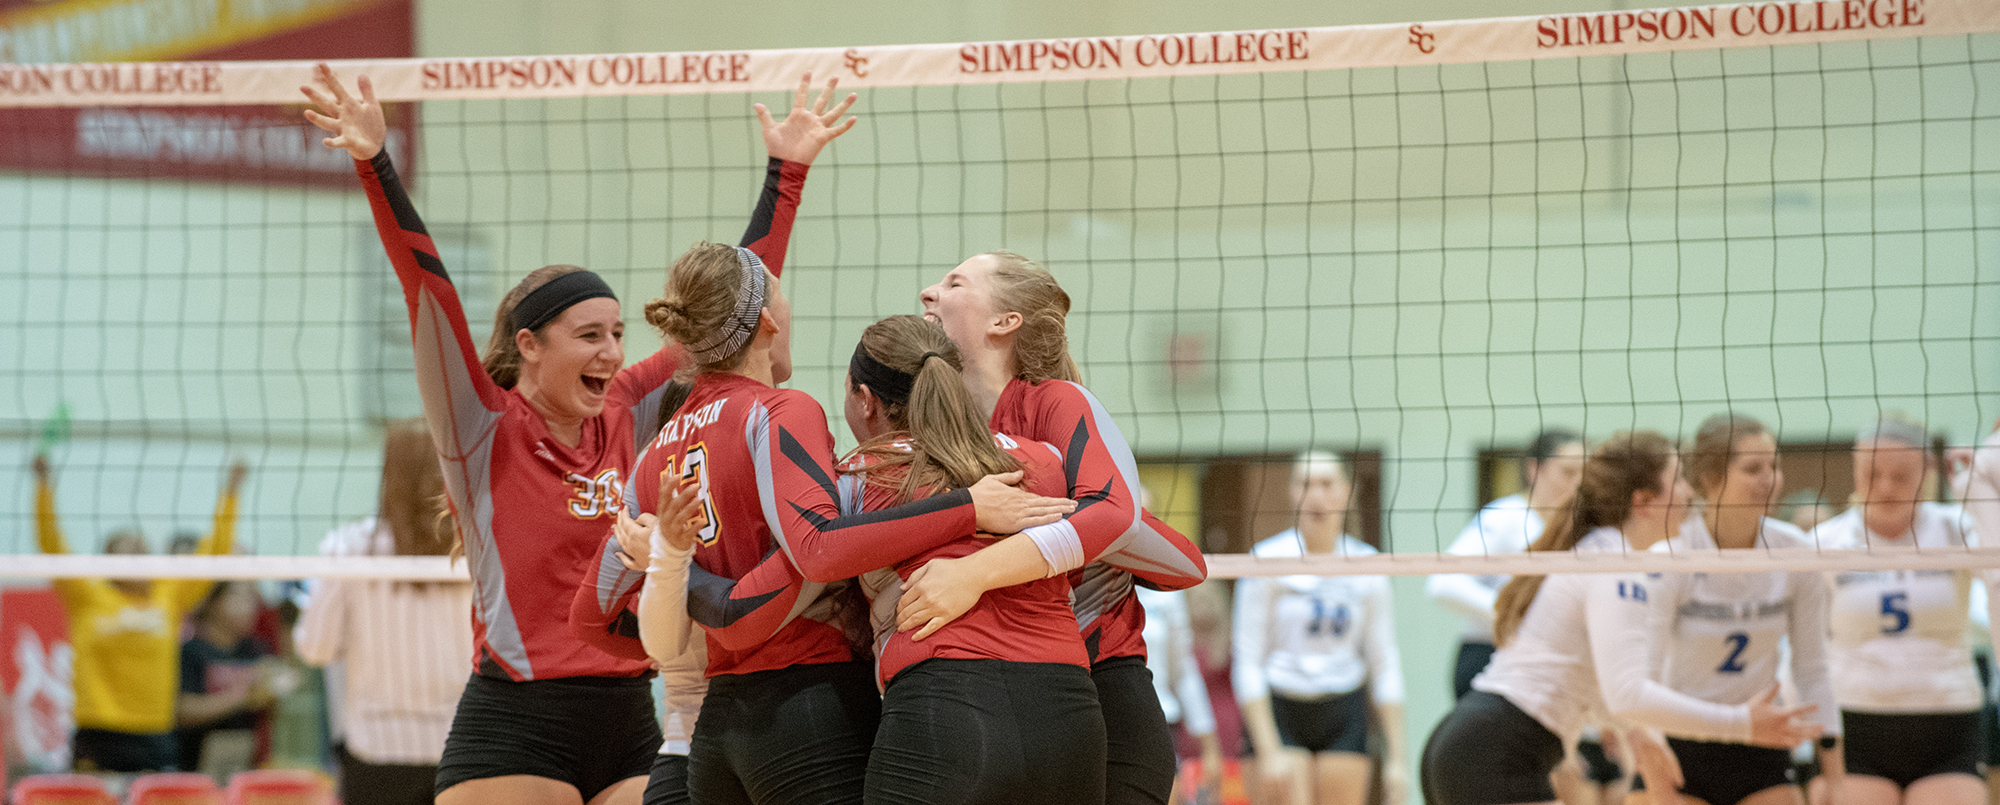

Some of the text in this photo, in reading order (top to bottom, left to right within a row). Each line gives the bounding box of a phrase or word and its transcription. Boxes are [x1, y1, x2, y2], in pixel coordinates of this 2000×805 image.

[1537, 0, 1926, 48] SIMPSON COLLEGE
[421, 54, 751, 90] SIMPSON COLLEGE
[959, 31, 1310, 74] SIMPSON COLLEGE
[62, 66, 223, 95] COLLEGE
[1880, 592, 1911, 635] 5
[1715, 631, 1749, 674] 2
